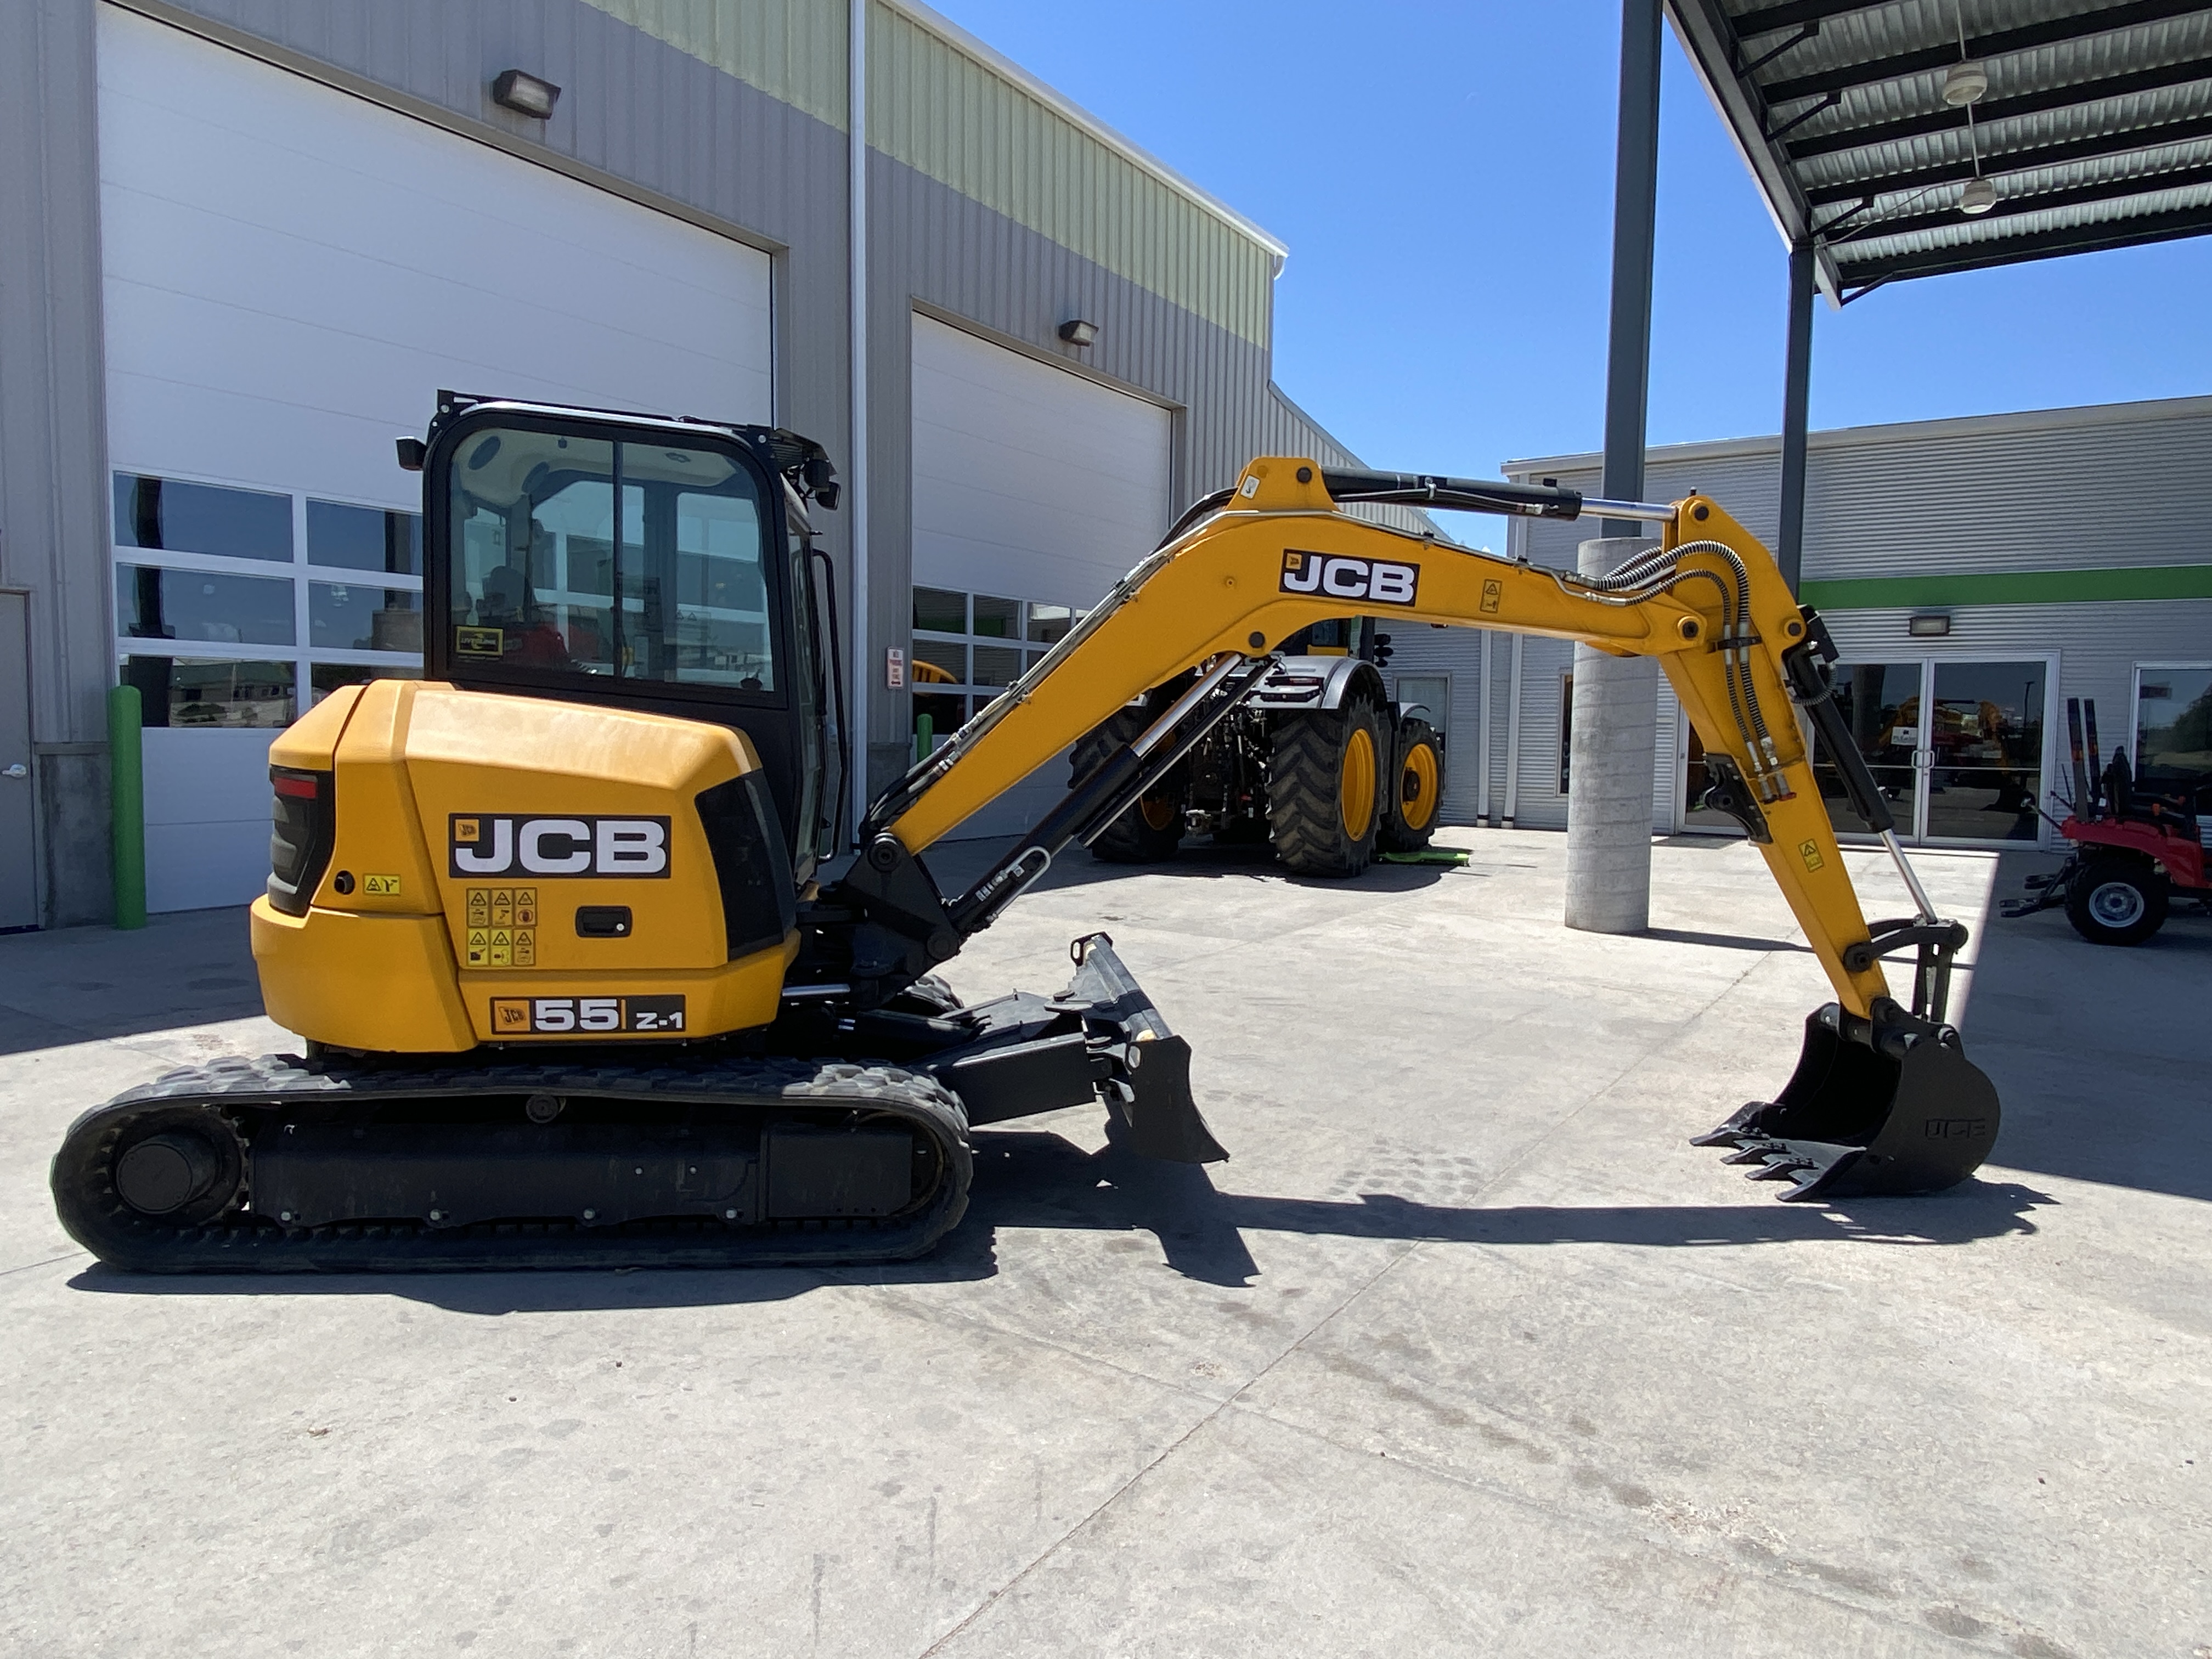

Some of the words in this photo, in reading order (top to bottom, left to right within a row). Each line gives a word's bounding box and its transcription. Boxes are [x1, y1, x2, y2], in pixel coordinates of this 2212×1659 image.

[1284, 556, 1415, 602] JCB
[455, 819, 666, 873] JCB
[535, 999, 619, 1030] 55
[636, 1012, 682, 1029] Z-1
